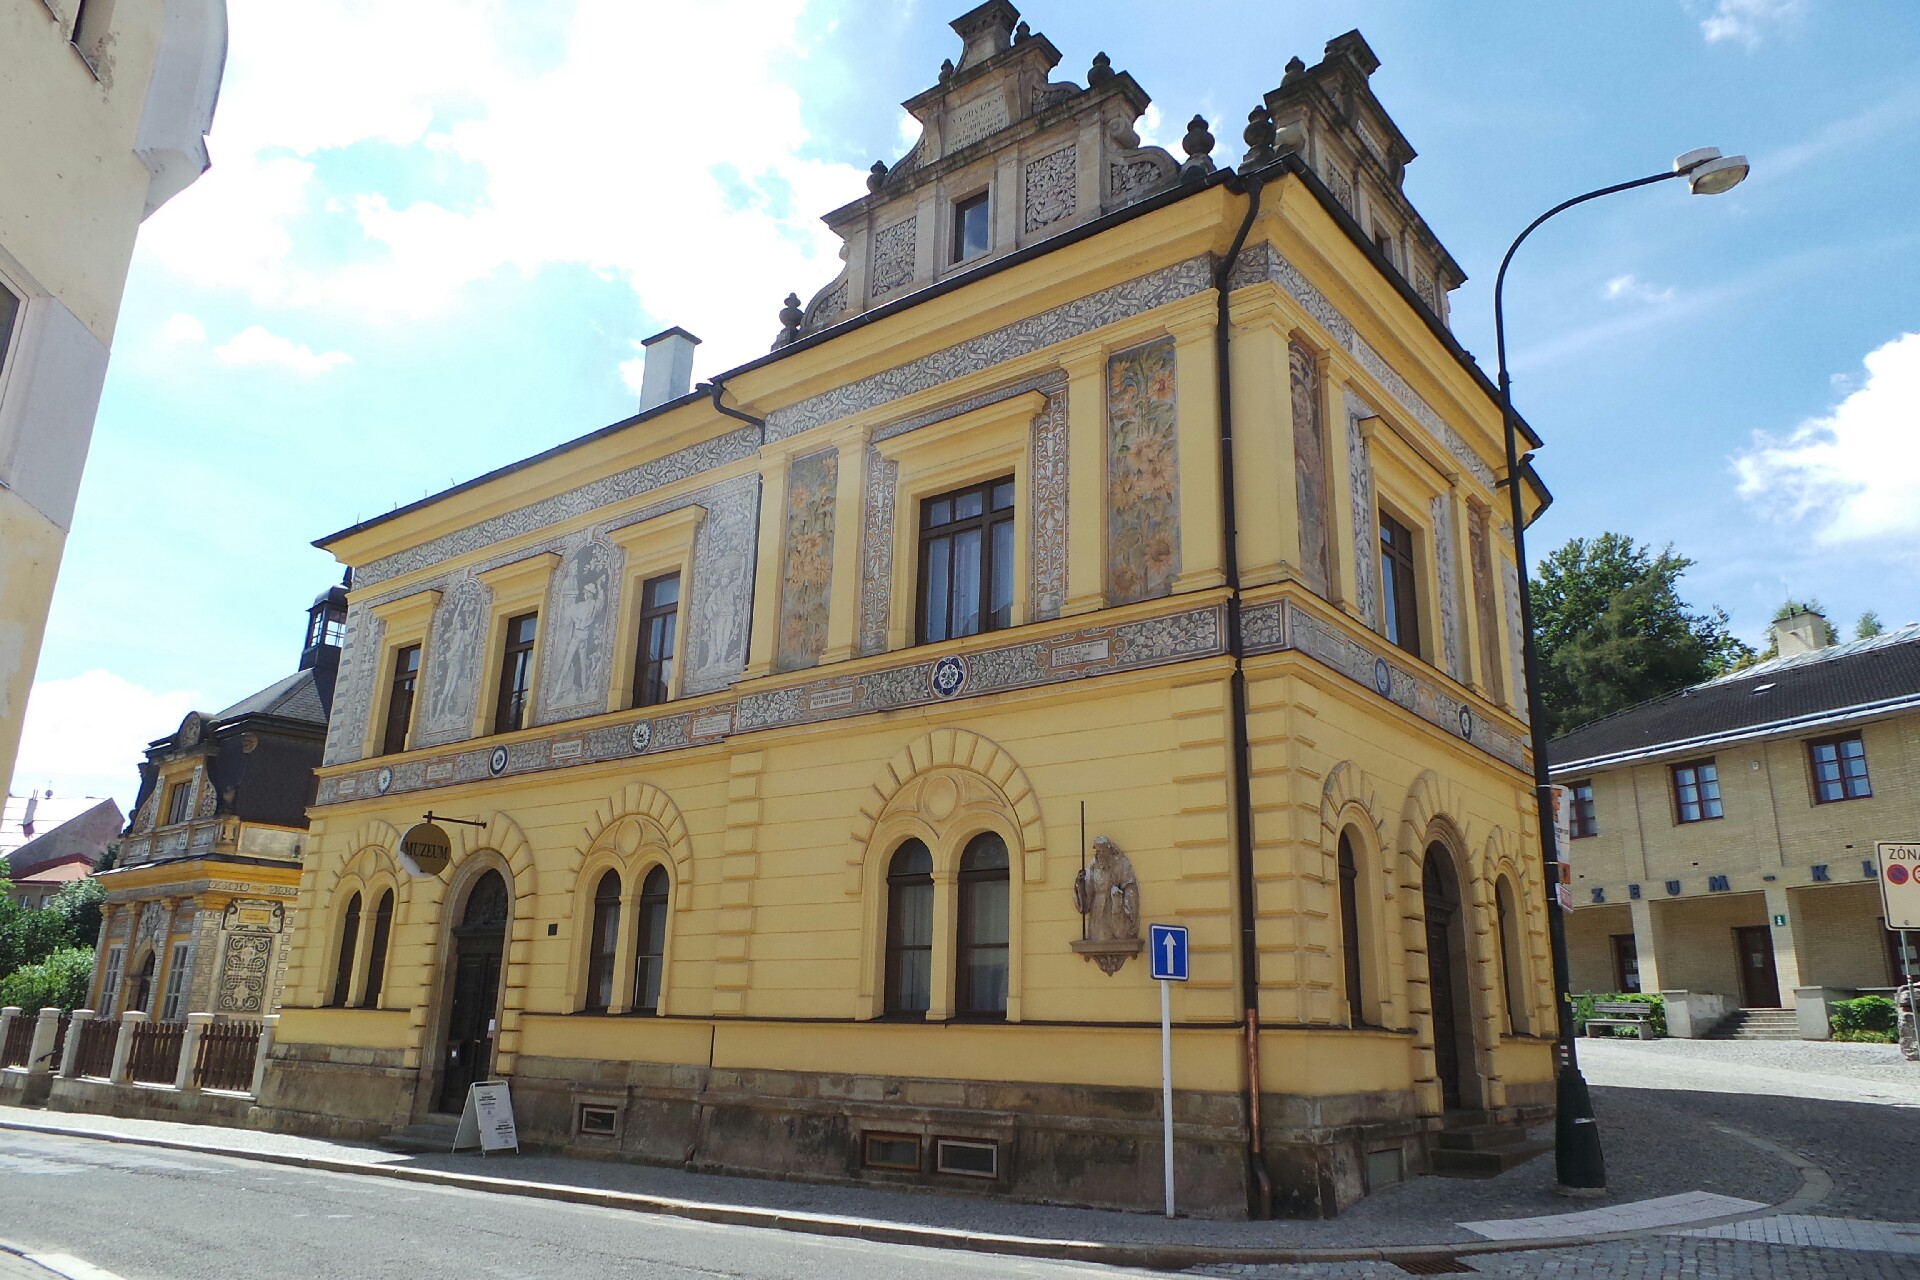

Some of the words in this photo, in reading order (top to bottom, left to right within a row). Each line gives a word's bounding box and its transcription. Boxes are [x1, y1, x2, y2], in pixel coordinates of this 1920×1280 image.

[404, 841, 449, 860] MUZEUM
[1888, 846, 1920, 860] ZÓN
[1591, 875, 1730, 903] ZEUM
[1811, 860, 1878, 882] KL
